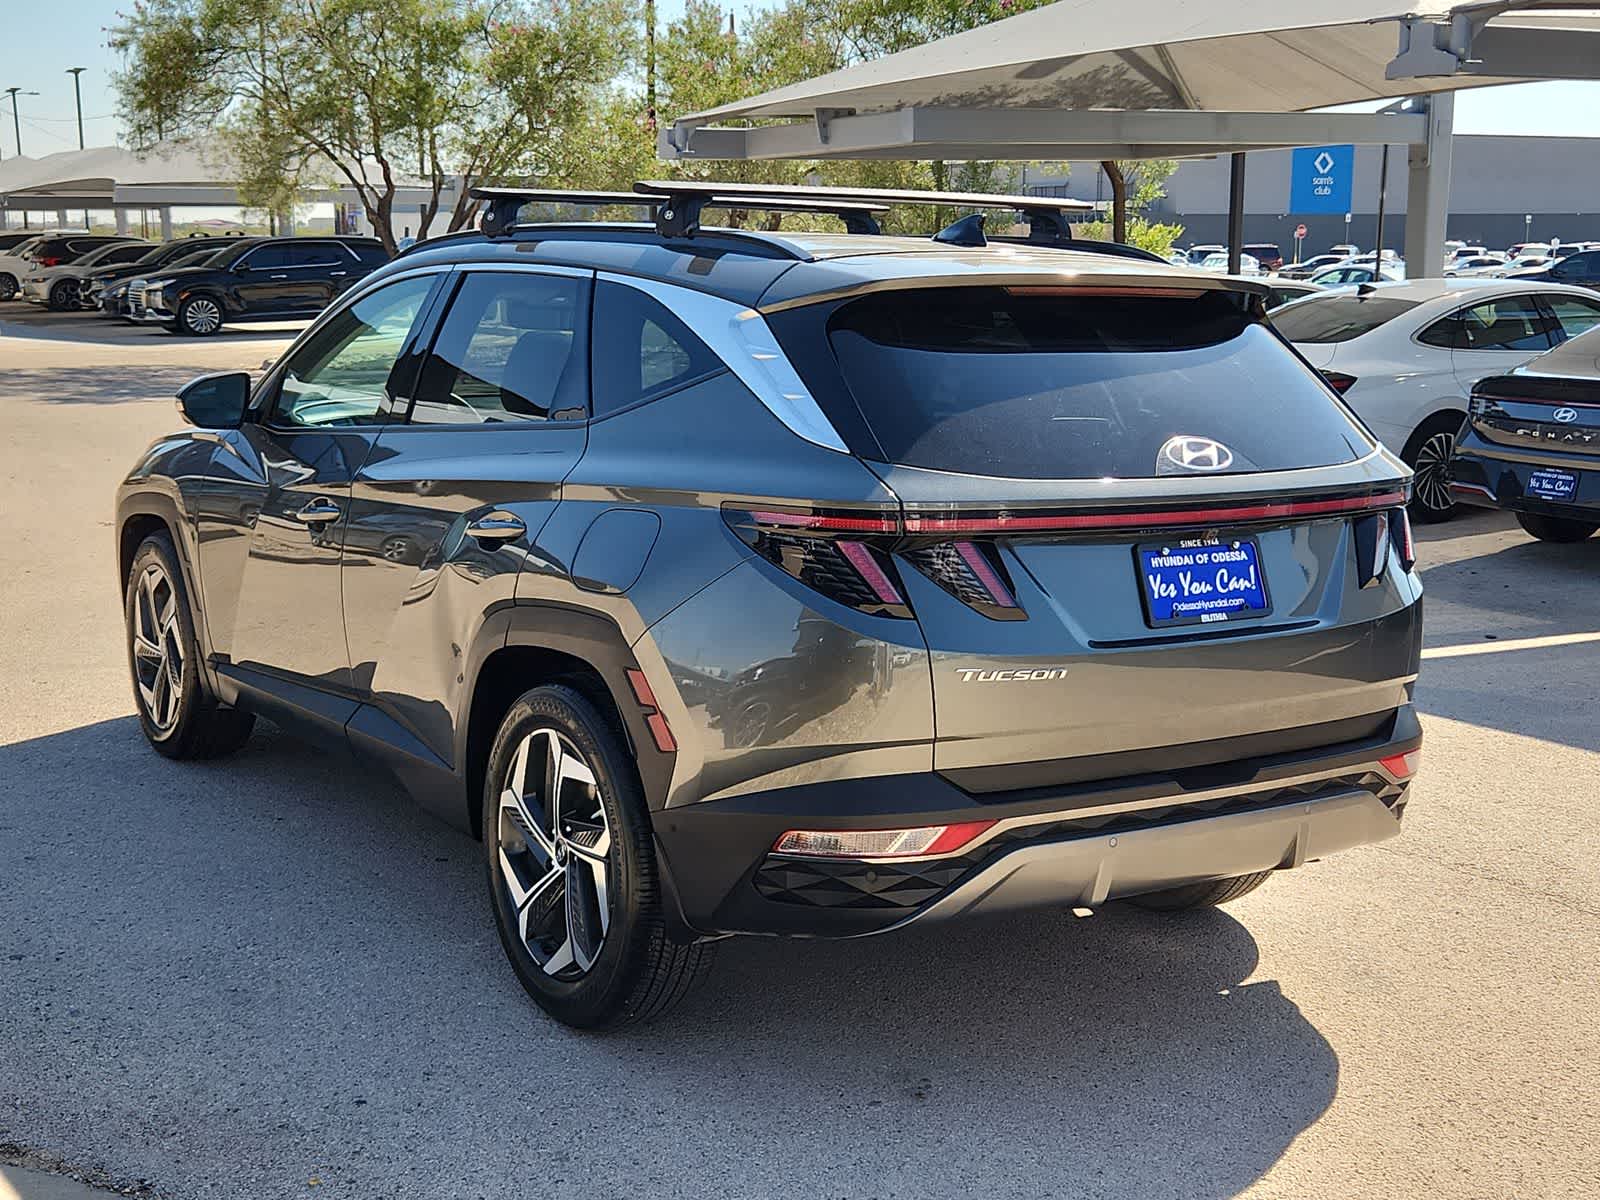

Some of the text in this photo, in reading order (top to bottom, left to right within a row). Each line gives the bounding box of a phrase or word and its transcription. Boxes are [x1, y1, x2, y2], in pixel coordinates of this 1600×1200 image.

[1312, 177, 1334, 185] sam's
[1314, 186, 1331, 195] club
[1180, 539, 1202, 548] SINCE
[1151, 550, 1248, 568] HYUNDAI OF ODESSA
[1148, 564, 1256, 599] Yes You Can!
[1173, 598, 1245, 611] OdessaHyundai.com
